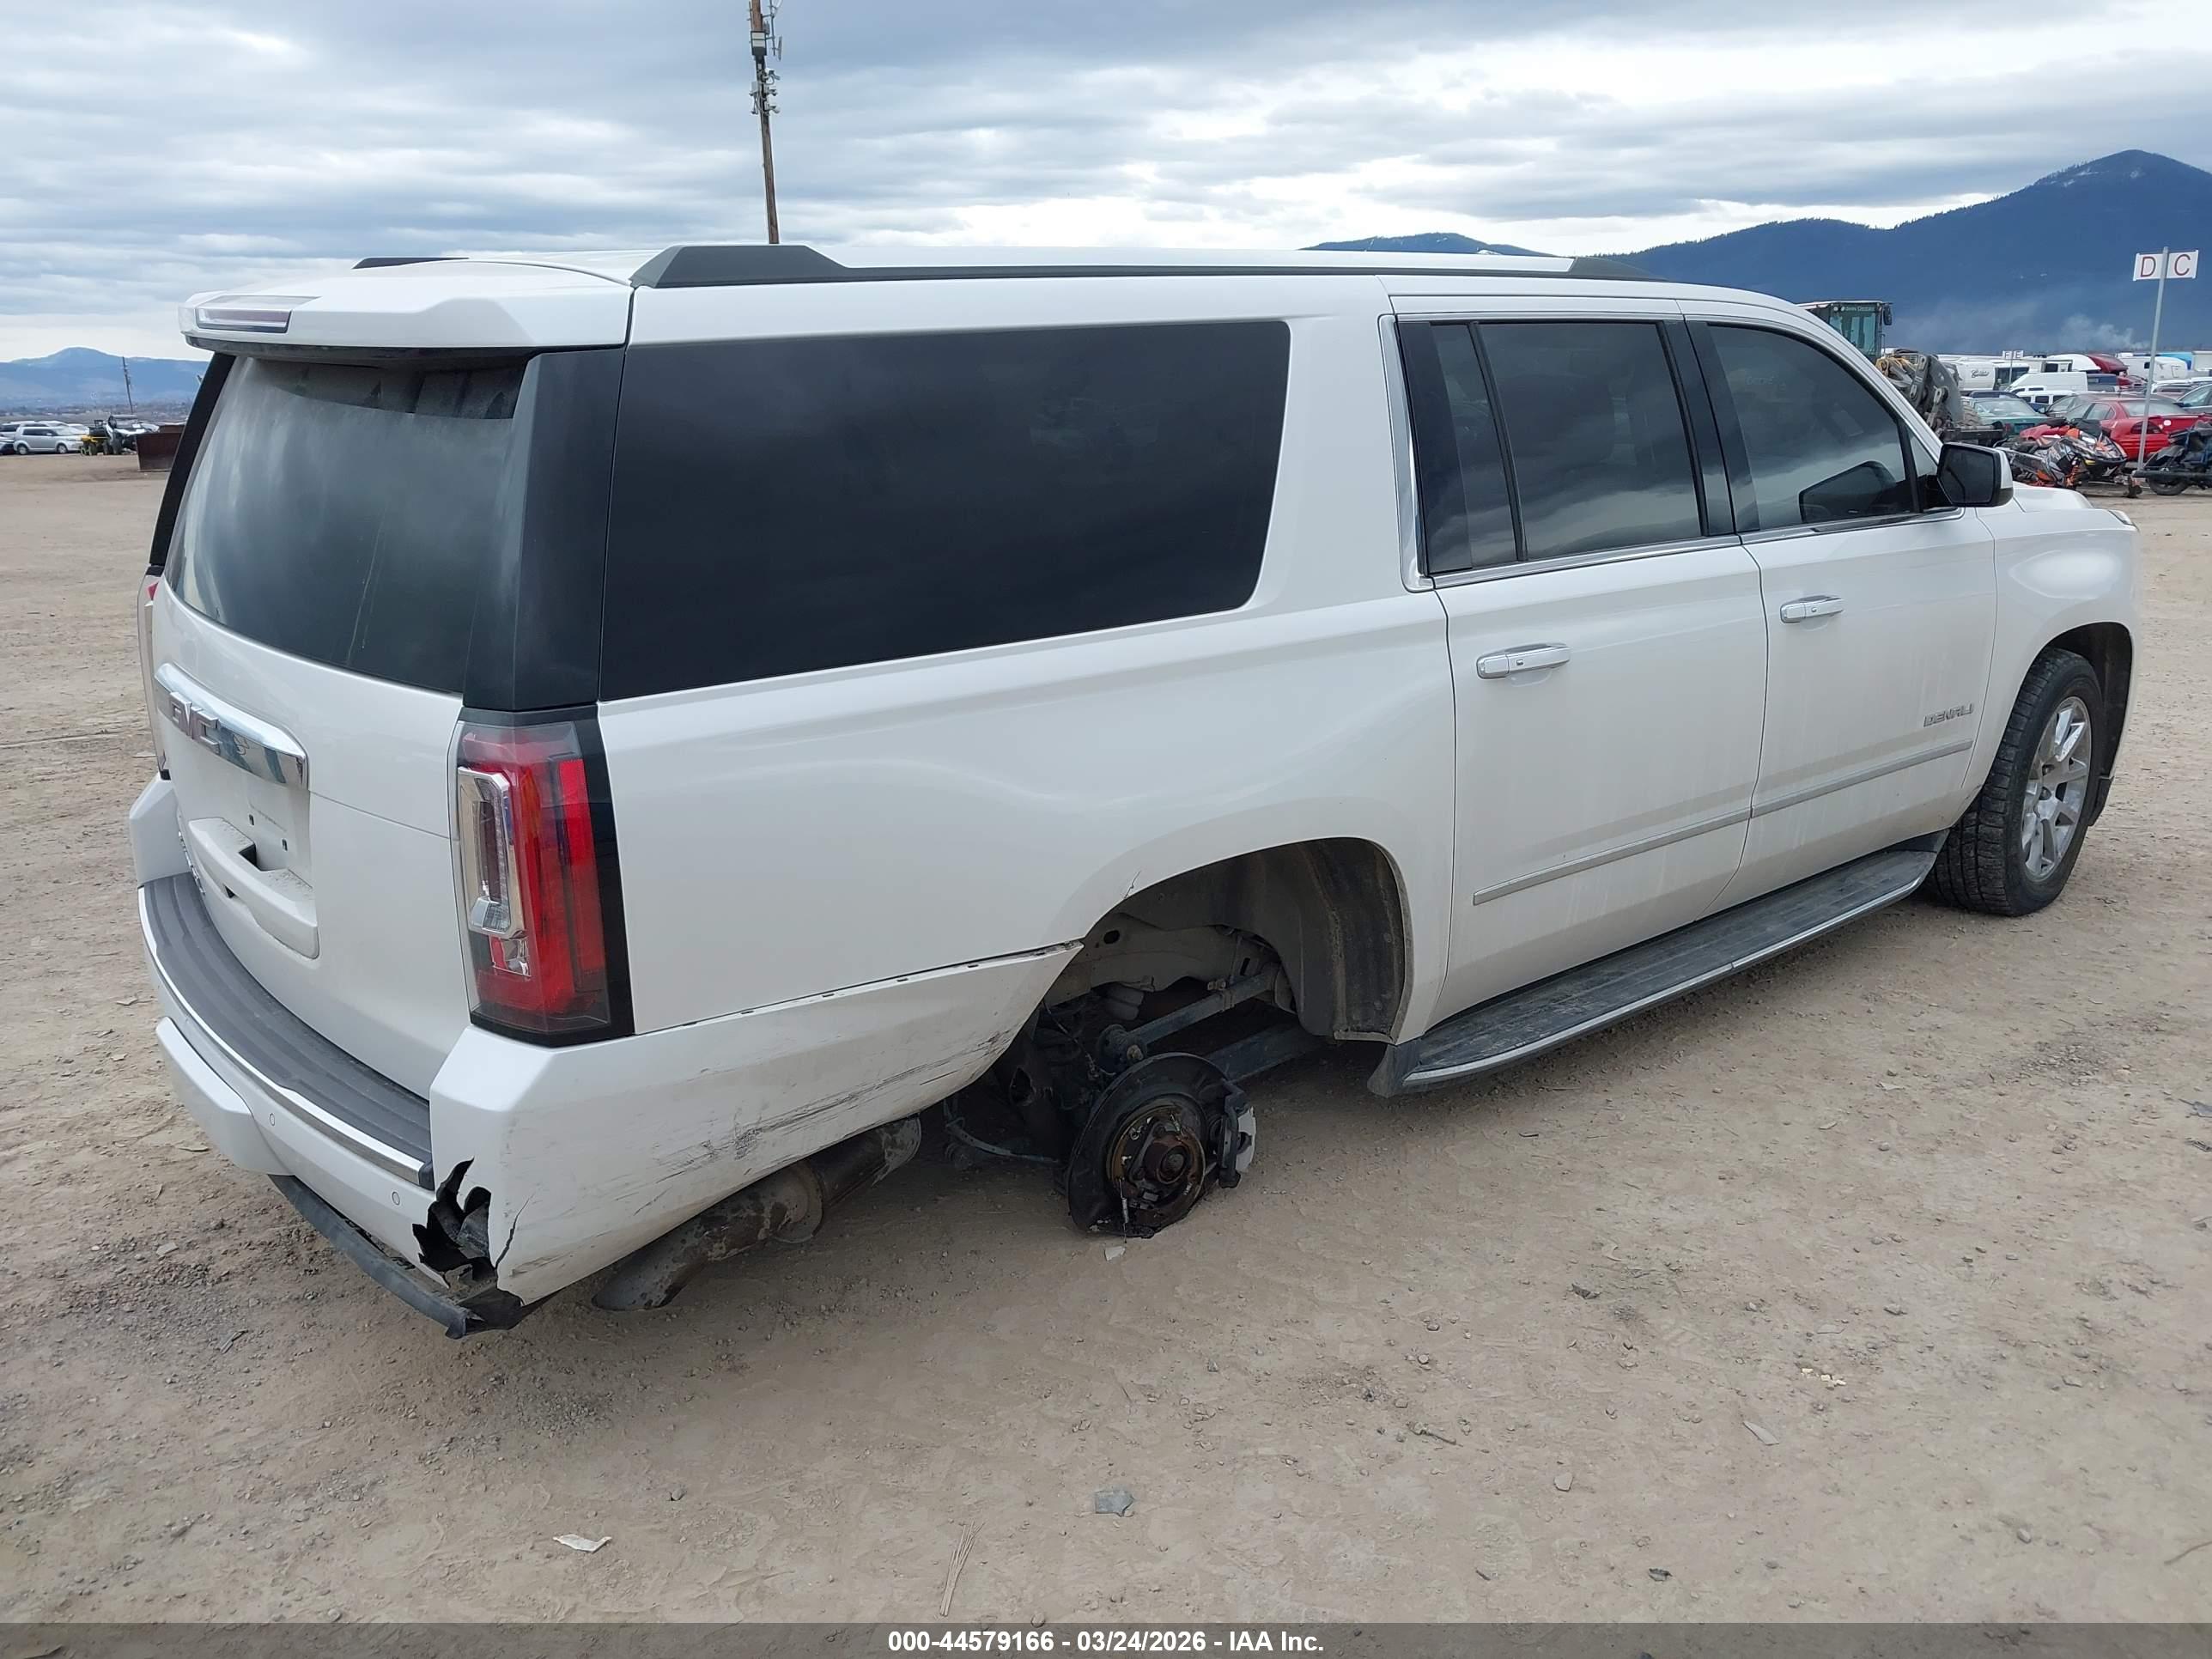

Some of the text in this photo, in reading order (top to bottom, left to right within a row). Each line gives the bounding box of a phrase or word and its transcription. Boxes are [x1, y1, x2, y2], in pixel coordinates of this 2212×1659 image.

[2141, 254, 2191, 277] D C
[170, 691, 222, 756] GMC
[1923, 703, 1974, 727] DENALI
